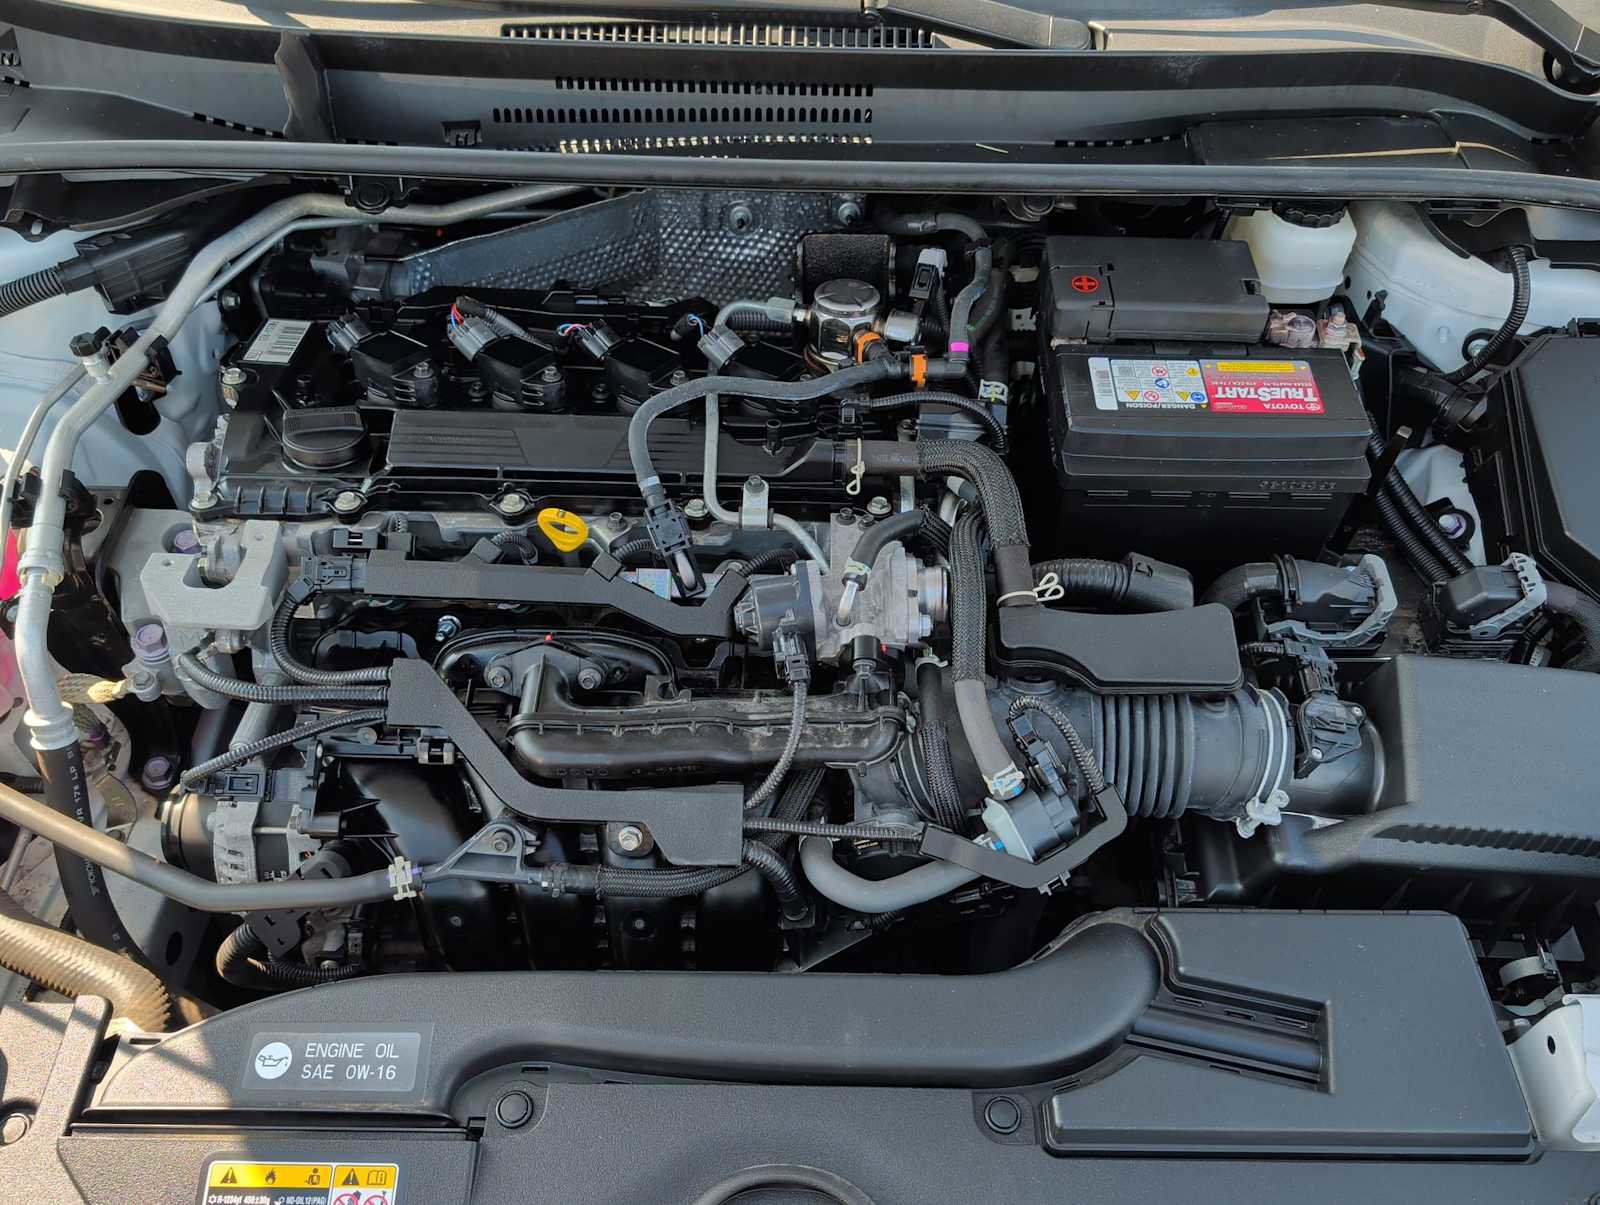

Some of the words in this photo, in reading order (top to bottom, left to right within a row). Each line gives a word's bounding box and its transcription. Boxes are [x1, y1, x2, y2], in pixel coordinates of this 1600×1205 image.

[305, 1042, 365, 1058] ENGINE
[375, 1042, 400, 1058] OIL
[301, 1064, 335, 1080] SAE
[345, 1064, 396, 1080] 0W-16
